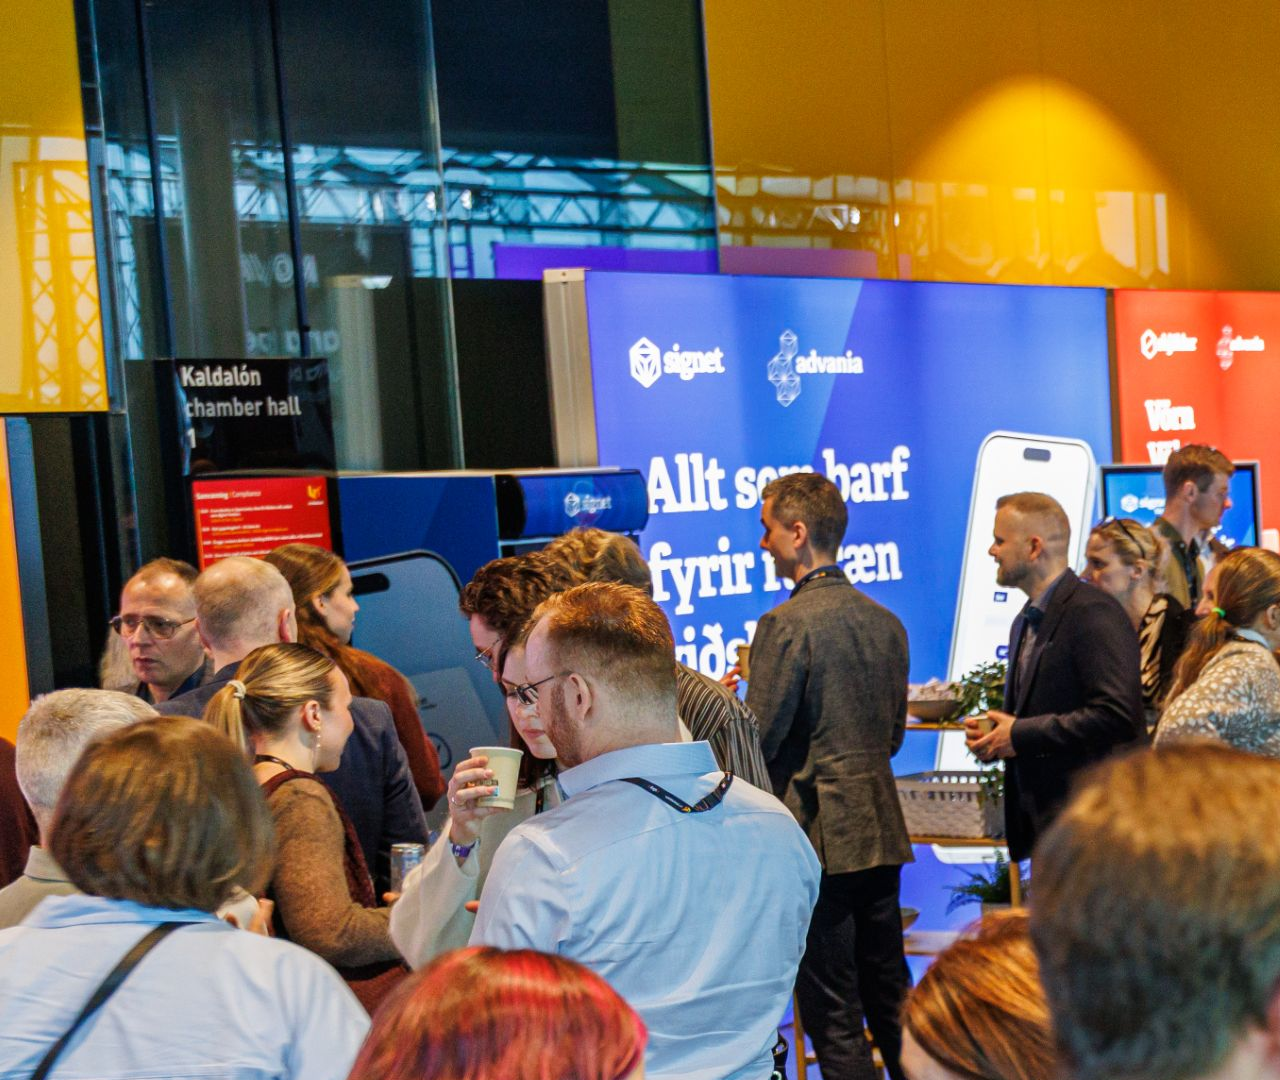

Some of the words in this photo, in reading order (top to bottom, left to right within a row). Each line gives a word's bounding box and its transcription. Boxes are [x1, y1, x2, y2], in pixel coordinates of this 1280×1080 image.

[181, 364, 262, 388] Kaldalón
[663, 342, 726, 381] signet
[795, 349, 864, 374] advania
[186, 396, 263, 418] chamber
[267, 395, 302, 416] hall
[648, 452, 729, 514] Allt
[648, 536, 755, 616] fyrir
